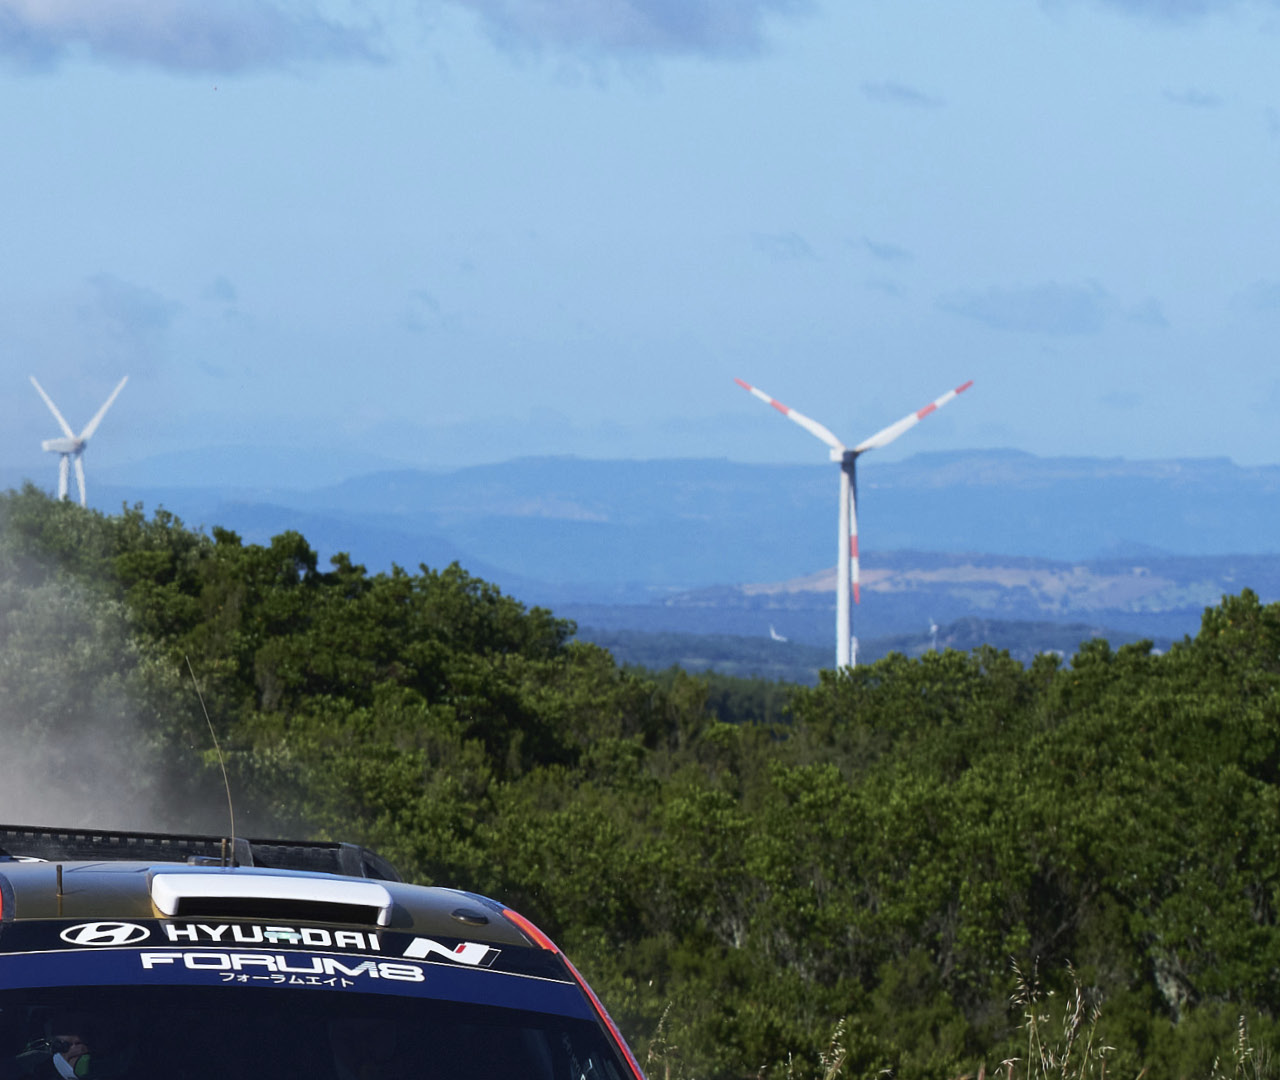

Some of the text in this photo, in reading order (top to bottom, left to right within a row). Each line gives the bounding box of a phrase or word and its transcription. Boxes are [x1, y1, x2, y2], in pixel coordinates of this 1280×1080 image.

[167, 923, 381, 951] HYUNDAI
[140, 952, 425, 983] FORUM8
[219, 972, 354, 988] フォーラムエイト
